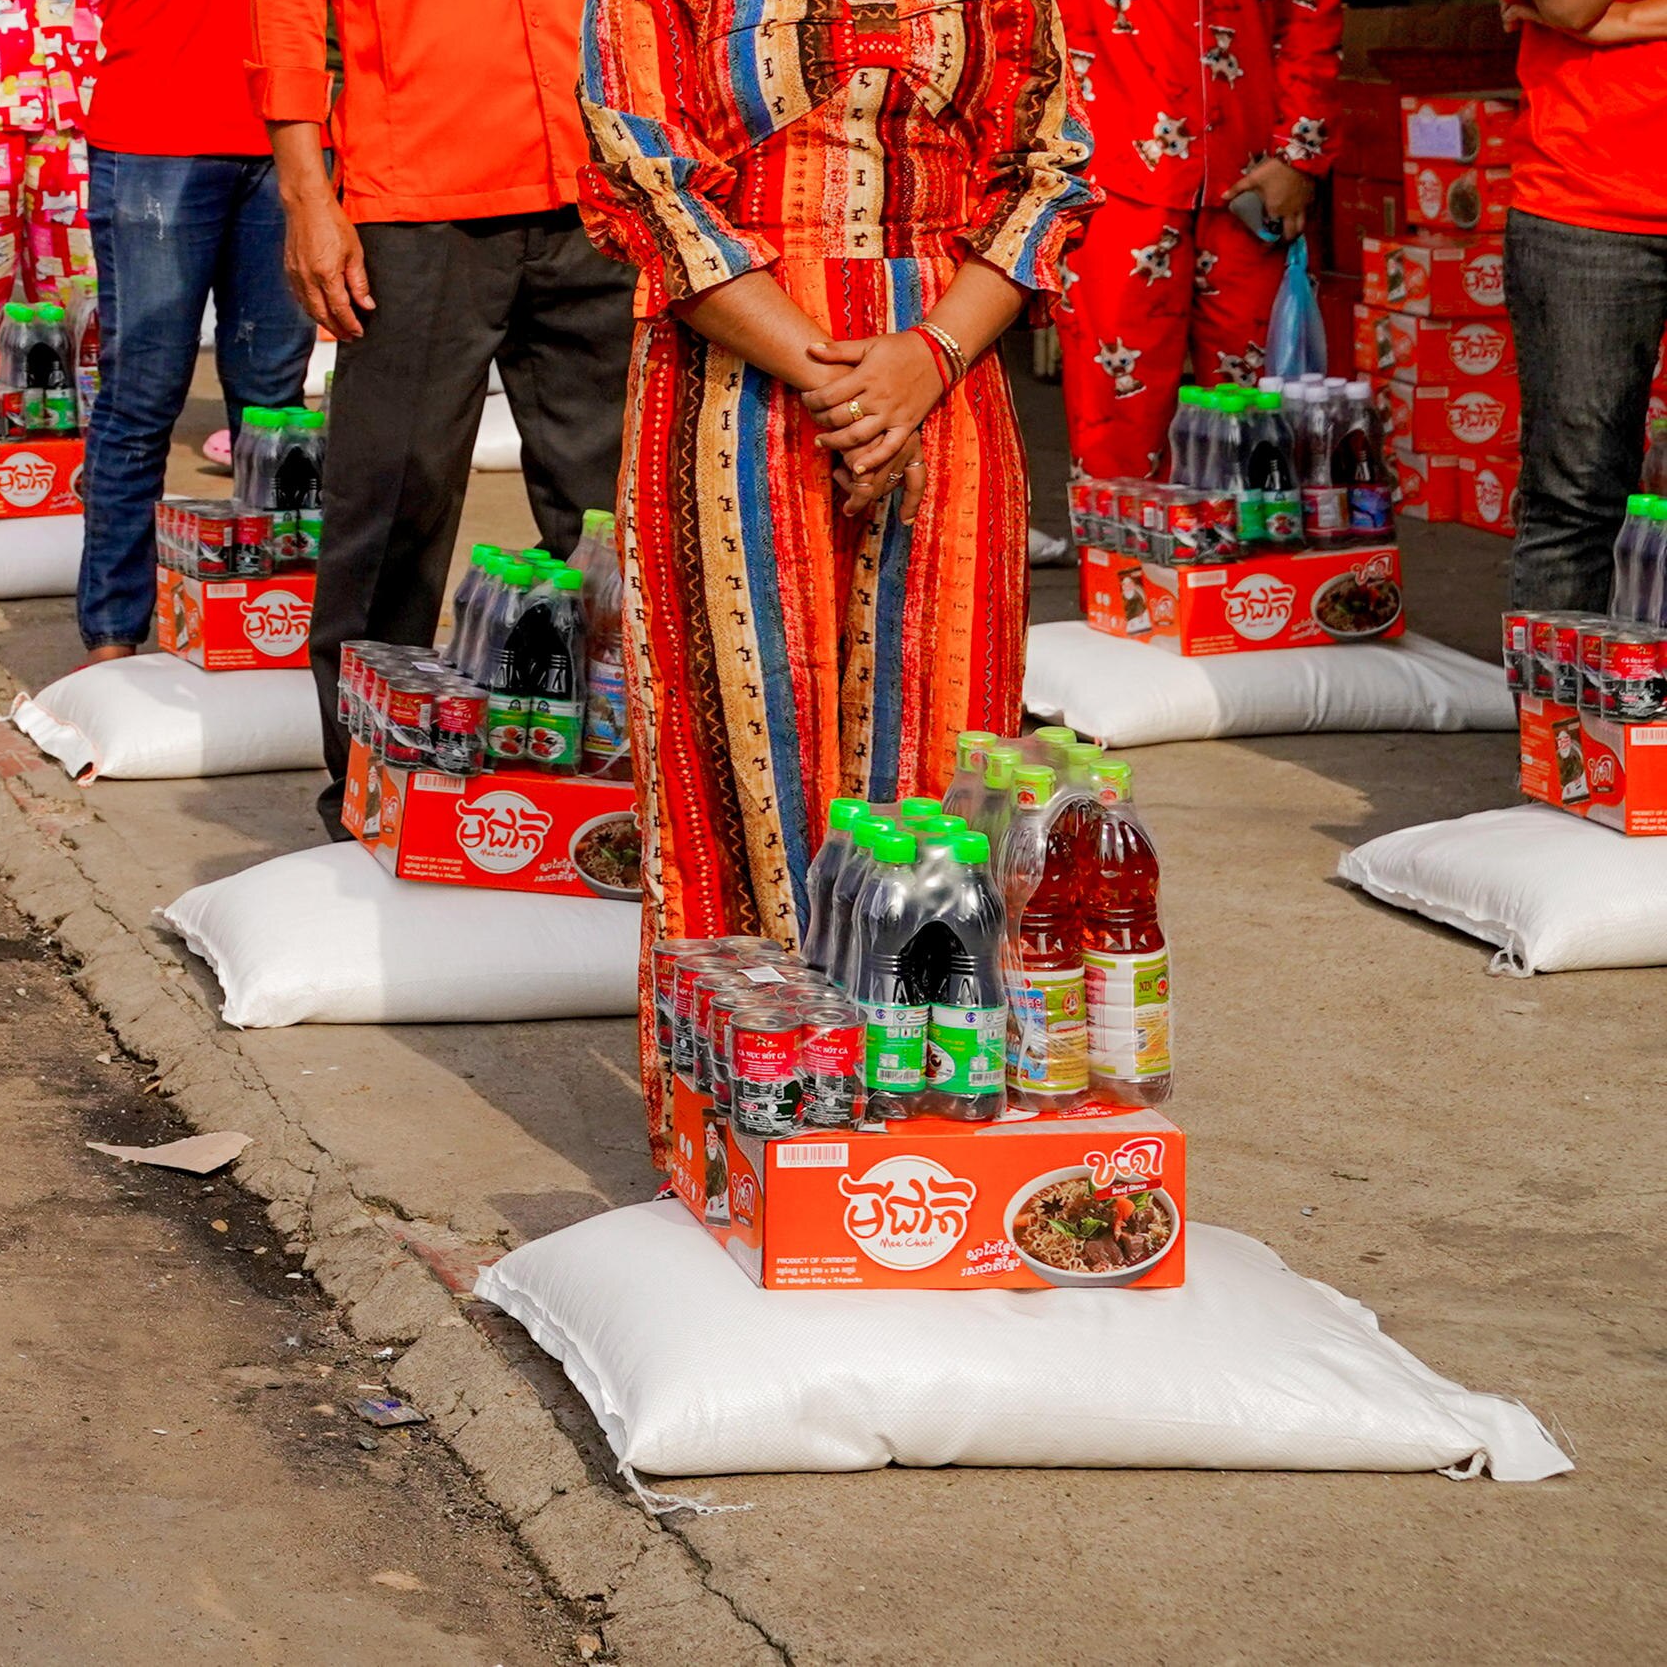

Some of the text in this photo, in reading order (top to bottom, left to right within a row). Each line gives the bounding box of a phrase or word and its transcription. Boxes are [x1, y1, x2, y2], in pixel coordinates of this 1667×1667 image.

[1084, 1137, 1164, 1188] ខគោ
[838, 1175, 975, 1240] មីជាតិ
[880, 1237, 903, 1248] Mee
